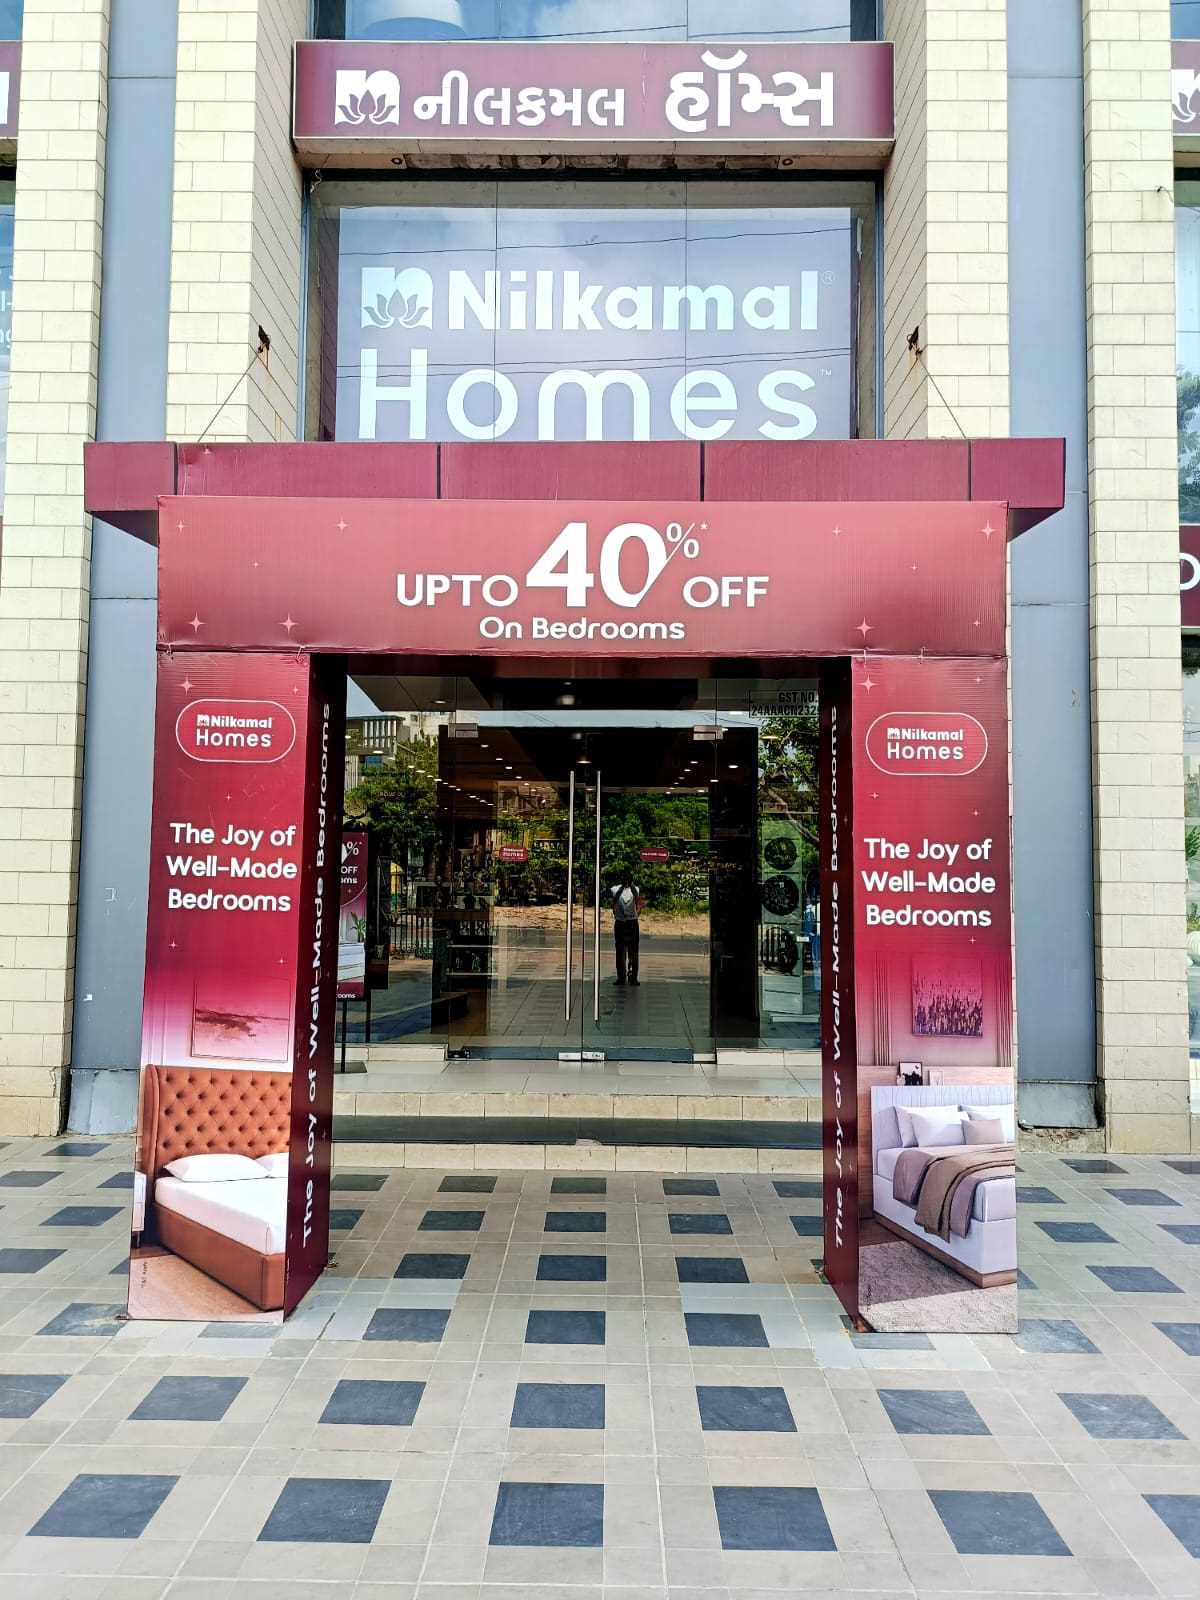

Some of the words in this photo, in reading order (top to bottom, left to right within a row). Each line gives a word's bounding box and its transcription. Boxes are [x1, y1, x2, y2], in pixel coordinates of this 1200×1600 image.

[413, 69, 625, 127] નીલકમલ
[448, 269, 819, 331] Nilkamal
[358, 348, 818, 441] Homes
[396, 573, 519, 608] UPTO
[682, 575, 769, 609] OFF
[479, 616, 523, 640] On
[532, 617, 686, 640] Bedrooms
[751, 703, 820, 717] 24AAACN232
[778, 691, 799, 703] GST
[211, 715, 273, 729] Nilkamal
[901, 728, 964, 741] Nilkamal
[195, 729, 272, 748] Homes
[887, 742, 964, 760] Homes
[316, 703, 330, 867] Bedrooms
[170, 822, 215, 845] The
[221, 824, 264, 851] Joy
[270, 825, 297, 847] of
[863, 838, 910, 859] The
[917, 838, 960, 866] Joy
[966, 838, 993, 860] of
[166, 855, 298, 879] Well-Made
[861, 870, 996, 894] Well-Made
[168, 888, 291, 912] Bedrooms
[866, 904, 992, 927] Bedrooms
[308, 1068, 317, 1102] of
[833, 1070, 842, 1109] of
[305, 1112, 317, 1169] Joy
[835, 1116, 844, 1178] Joy
[303, 1178, 313, 1249] The
[835, 1186, 843, 1249] The
